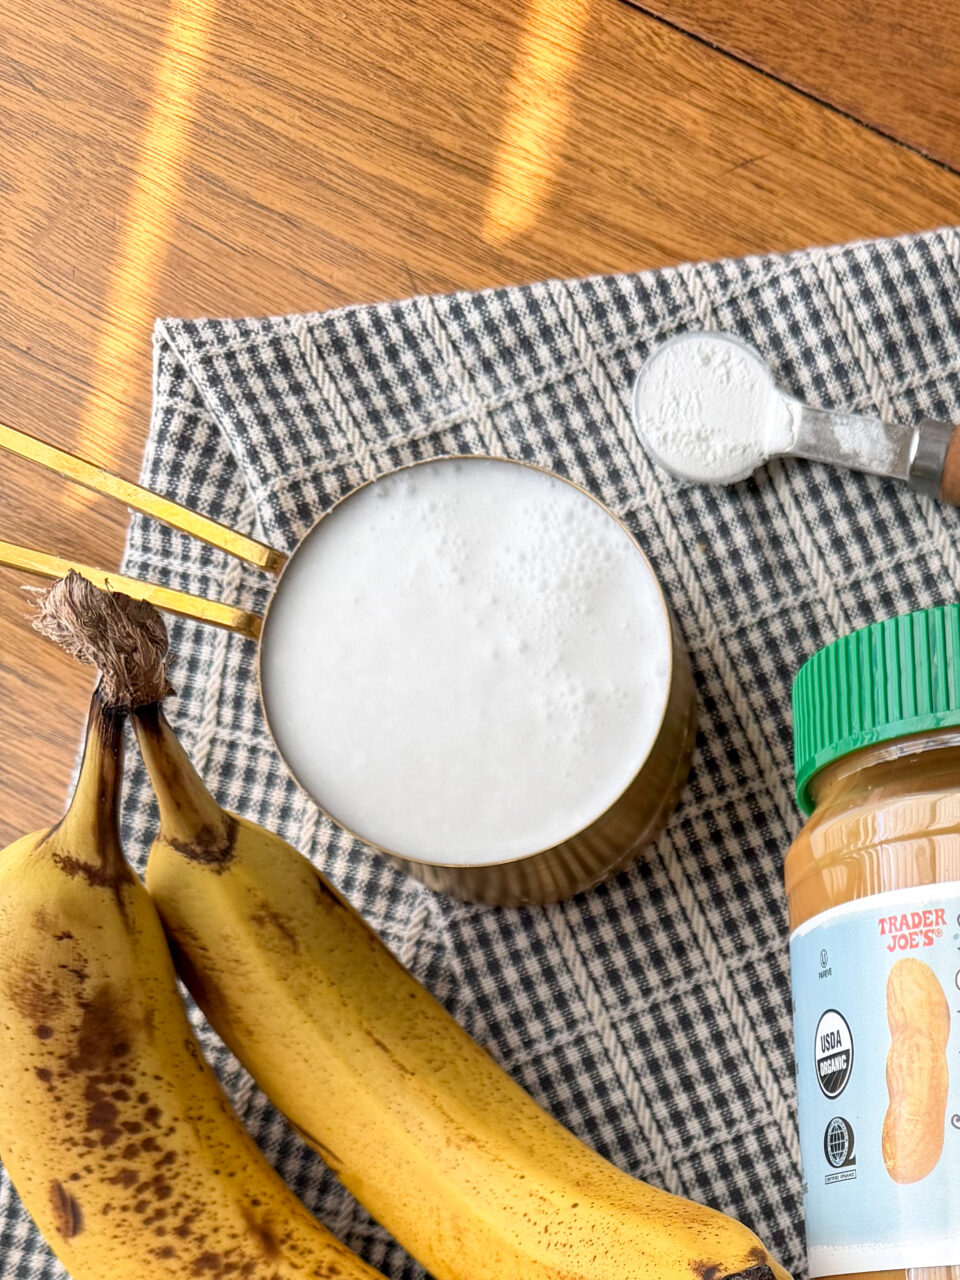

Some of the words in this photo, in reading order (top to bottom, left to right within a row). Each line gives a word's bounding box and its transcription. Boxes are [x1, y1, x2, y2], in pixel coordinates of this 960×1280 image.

[878, 909, 948, 937] TRADER
[821, 1029, 843, 1053] USDA
[820, 1054, 847, 1077] ORGANIC
